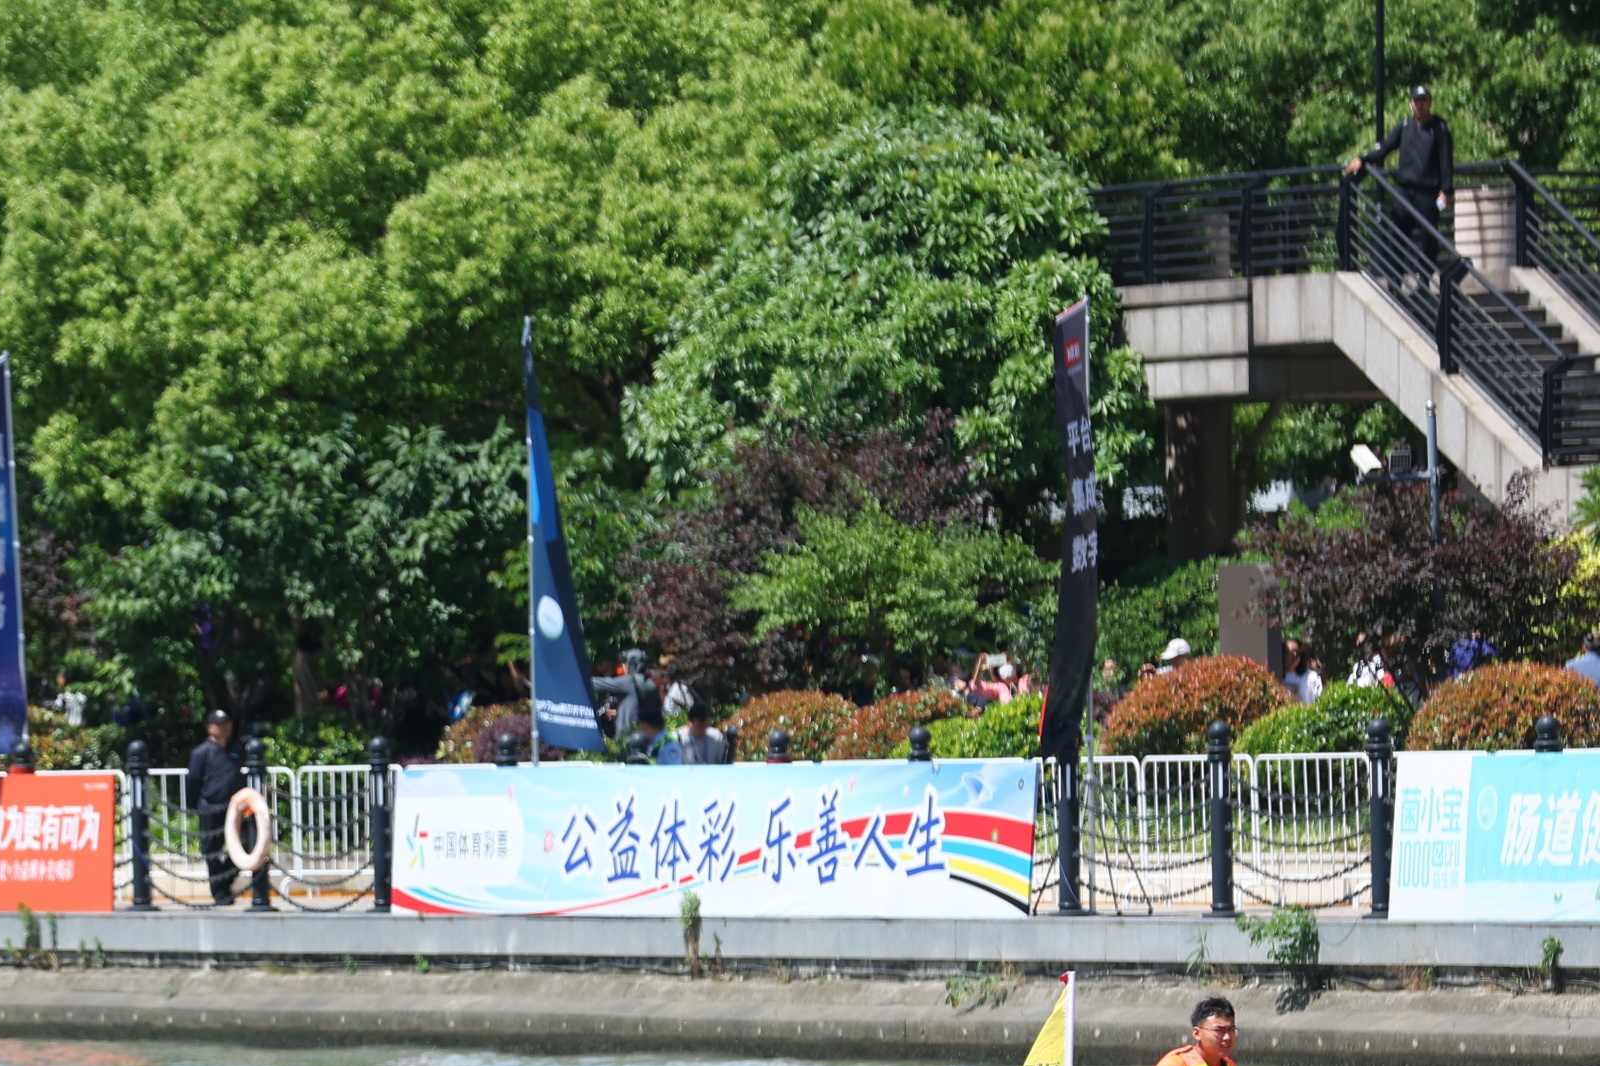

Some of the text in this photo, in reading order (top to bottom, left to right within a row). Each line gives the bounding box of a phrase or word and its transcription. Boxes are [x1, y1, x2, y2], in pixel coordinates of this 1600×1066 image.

[1400, 787, 1463, 833] 菌小宝
[433, 830, 508, 859] 中国体育彩票
[561, 788, 948, 885] 公益体彩 乐善人生
